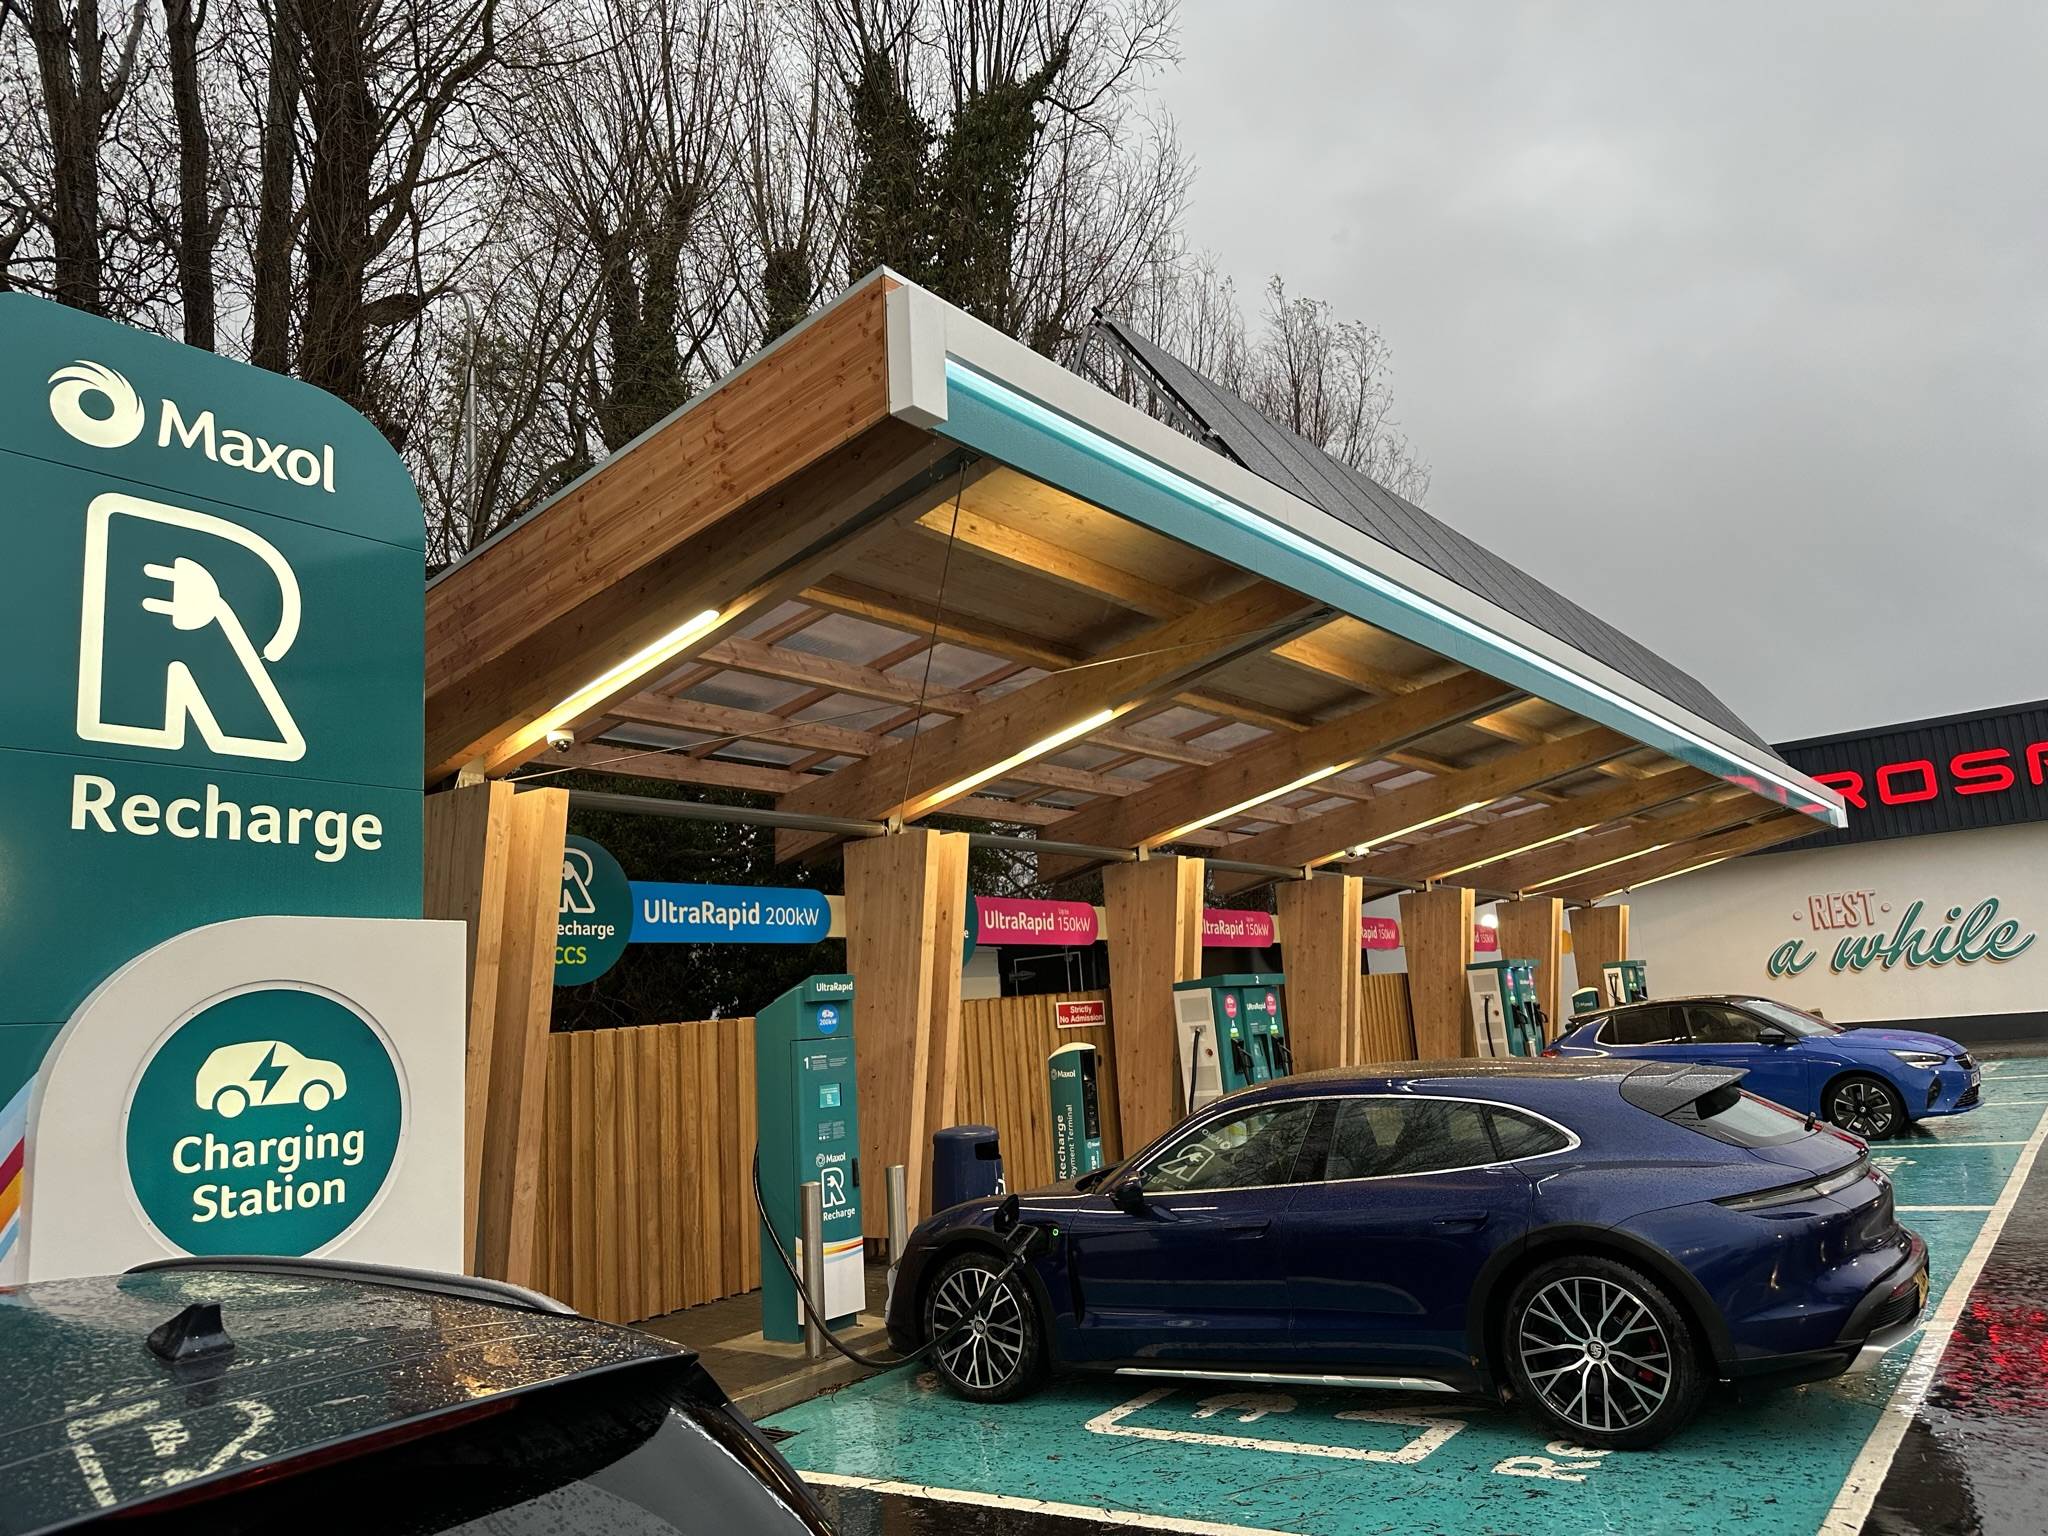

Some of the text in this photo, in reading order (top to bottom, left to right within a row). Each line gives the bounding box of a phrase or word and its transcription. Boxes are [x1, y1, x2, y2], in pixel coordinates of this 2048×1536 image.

[157, 399, 337, 494] Maxol
[70, 773, 383, 863] Recharge
[643, 898, 820, 931] UltraRapid 200kW
[984, 910, 1055, 936] UltraRapid
[1057, 916, 1091, 932] 150kW
[1808, 888, 1876, 931] REST
[557, 920, 615, 940] echarge
[1202, 918, 1270, 940] ltraRapid 150kW
[1766, 896, 2037, 980] a while
[816, 981, 854, 993] UltraRapid
[1059, 1013, 1104, 1024] No Admission
[1070, 1005, 1093, 1015] Strictly
[1066, 1104, 1075, 1142] Terminal
[172, 1124, 366, 1175] Charging
[826, 1152, 846, 1164] Maxol
[1057, 1115, 1068, 1180] Recharge
[191, 1173, 347, 1223] Station
[823, 1206, 856, 1222] Recharge
